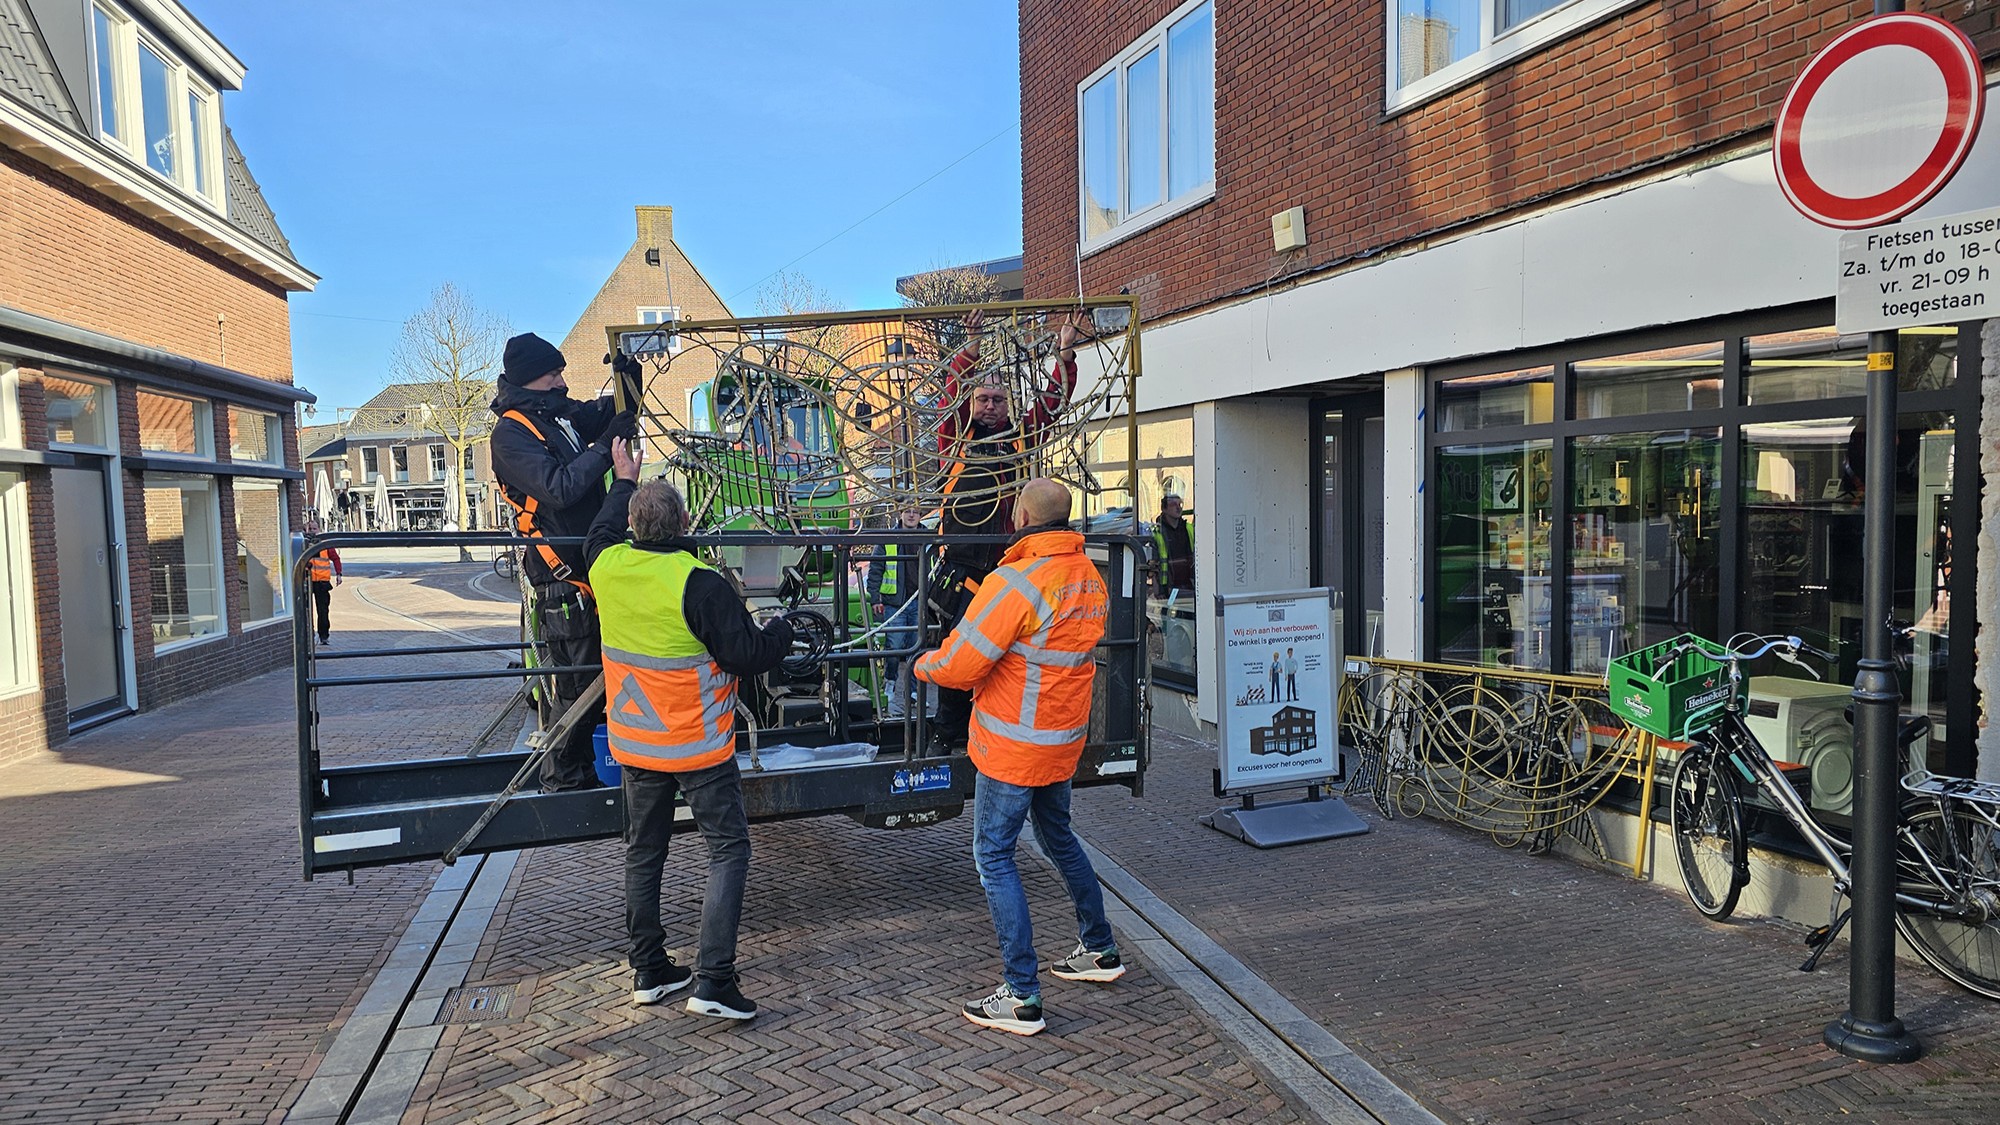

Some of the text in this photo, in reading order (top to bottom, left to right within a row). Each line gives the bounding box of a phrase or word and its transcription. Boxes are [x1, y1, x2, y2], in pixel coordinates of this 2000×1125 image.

[1868, 229, 1934, 250] Fietsen
[1843, 261, 1871, 277] Za.
[1880, 253, 1916, 272] t/m
[1924, 249, 1945, 265] do
[1880, 265, 1989, 294] vr. 21-09 h
[1882, 292, 1985, 318] toegestaan
[1235, 520, 1246, 584] AQUAPANEL
[1228, 639, 1238, 647] De
[1239, 637, 1261, 646] winkel
[1261, 637, 1267, 645] is
[1268, 636, 1293, 646] gewoon
[1293, 633, 1321, 643] geopend
[1233, 628, 1245, 637] Wij
[1246, 627, 1257, 637] zijn
[1271, 625, 1282, 633] het
[1282, 623, 1320, 633] verbouwen.
[1688, 688, 1729, 708] Heineken
[1237, 764, 1263, 773] Excuses
[1280, 760, 1292, 768] het
[1292, 757, 1323, 767] ongemak
